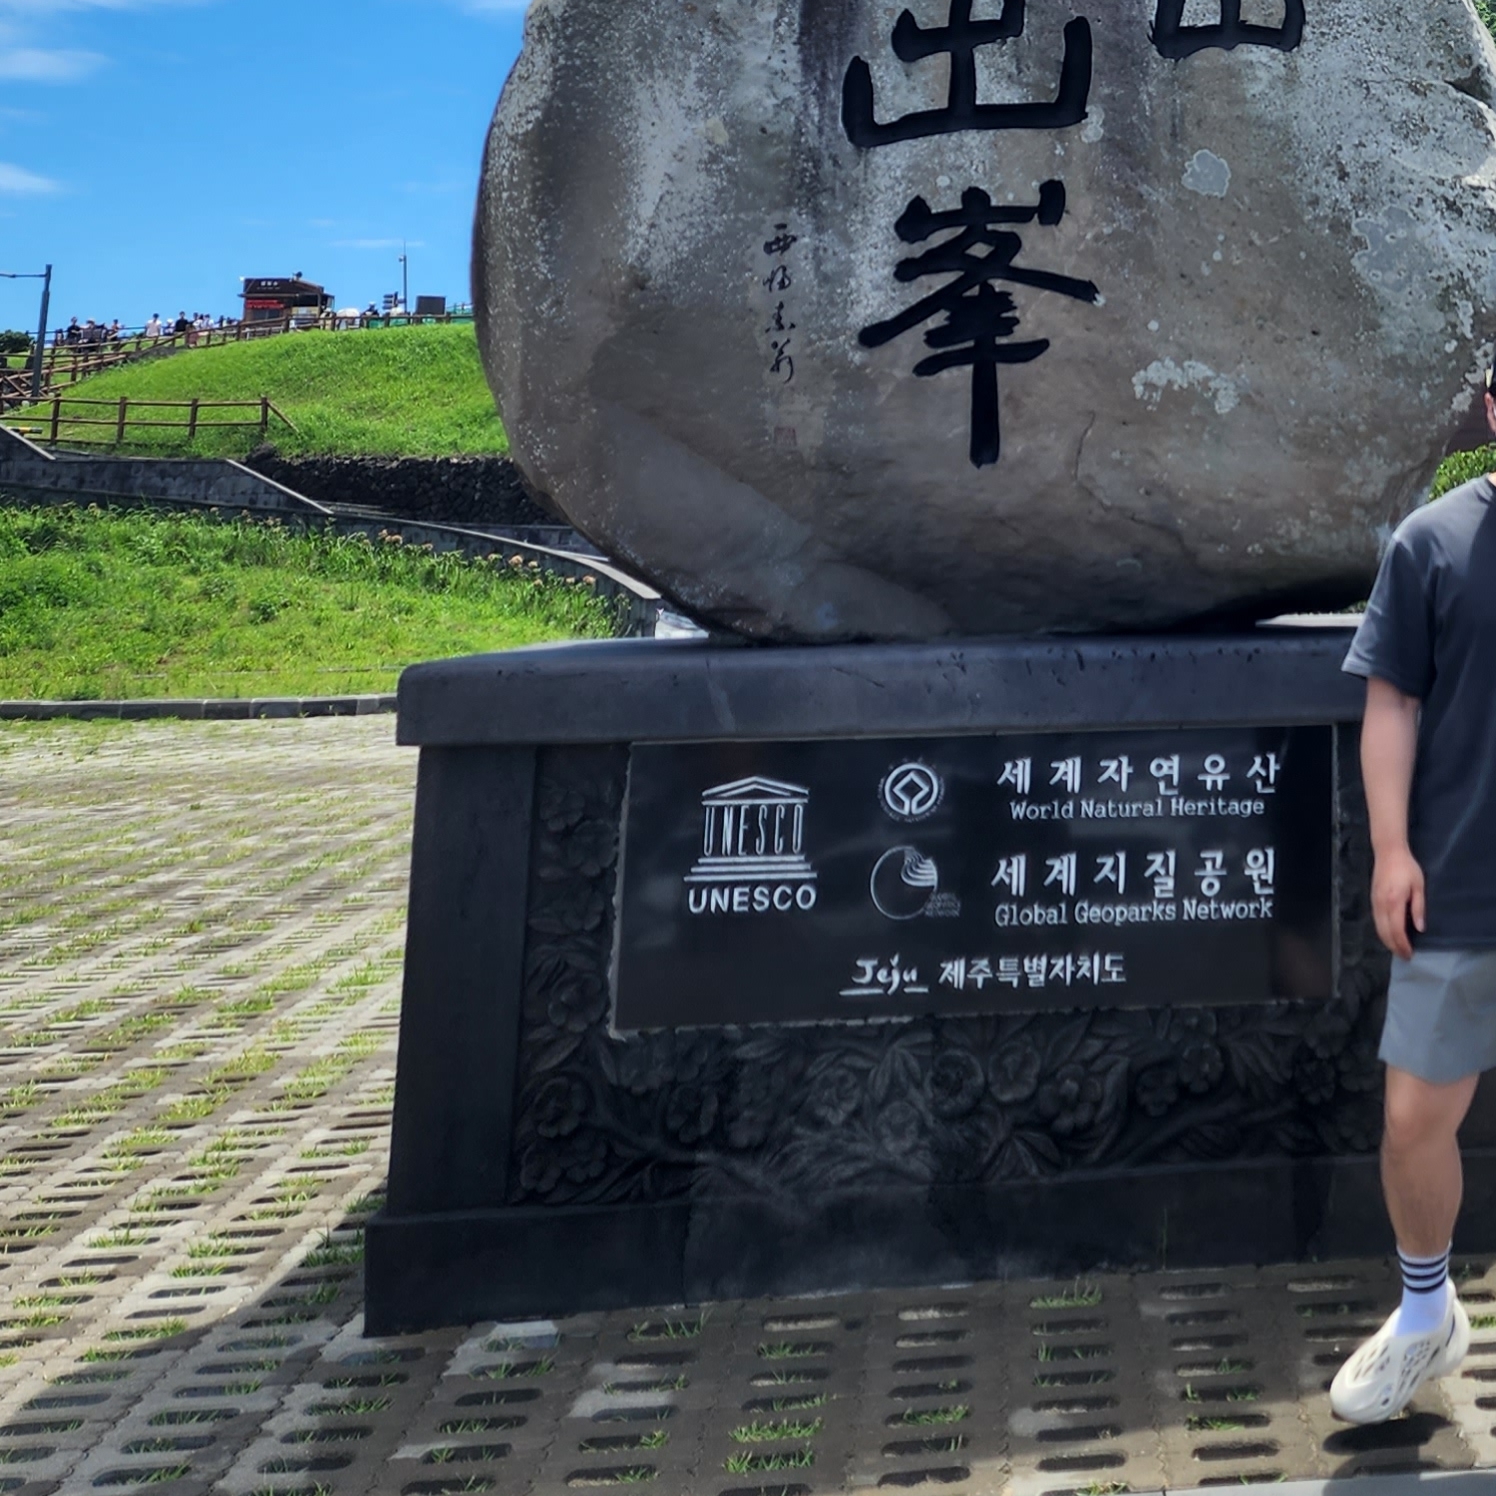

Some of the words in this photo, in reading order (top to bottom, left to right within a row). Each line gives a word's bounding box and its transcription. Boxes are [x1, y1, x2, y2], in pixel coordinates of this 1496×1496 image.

[1010, 799, 1074, 821] World
[1080, 797, 1163, 819] Natural
[1170, 795, 1265, 818] Heritage
[703, 803, 804, 857] UNESCO
[688, 884, 817, 914] UNESCO
[994, 901, 1069, 927] Global
[1073, 897, 1177, 927] Geoparks
[1181, 896, 1273, 921] Network
[937, 949, 1128, 990] 제주특별자치도
